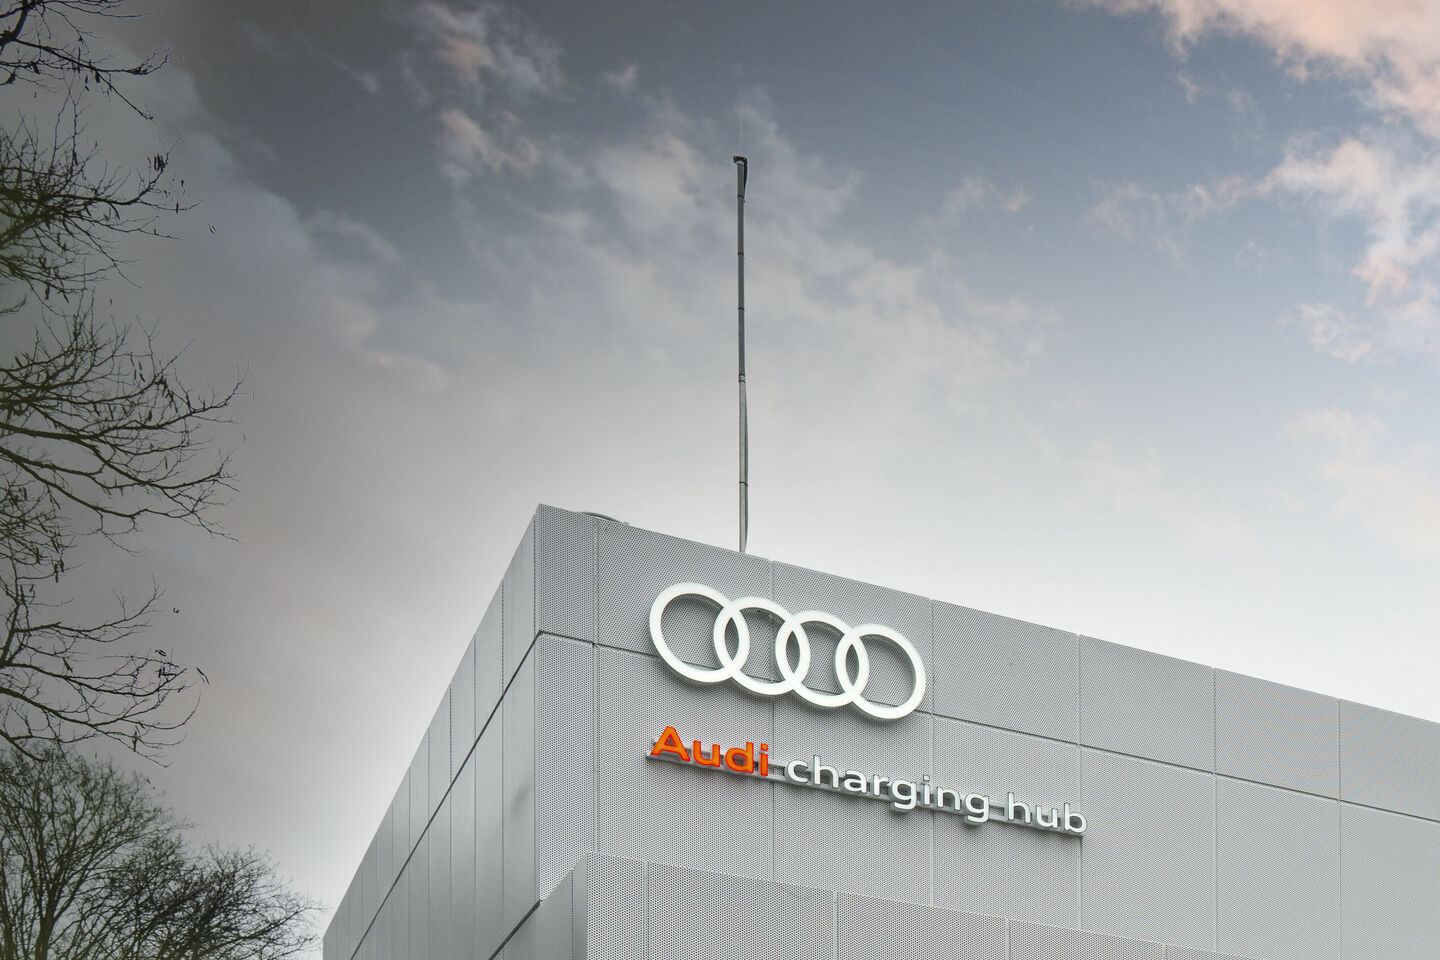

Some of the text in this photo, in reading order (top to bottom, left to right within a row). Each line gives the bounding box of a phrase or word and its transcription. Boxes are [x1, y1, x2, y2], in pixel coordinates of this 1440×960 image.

[651, 726, 1087, 834] Audi charging hub
